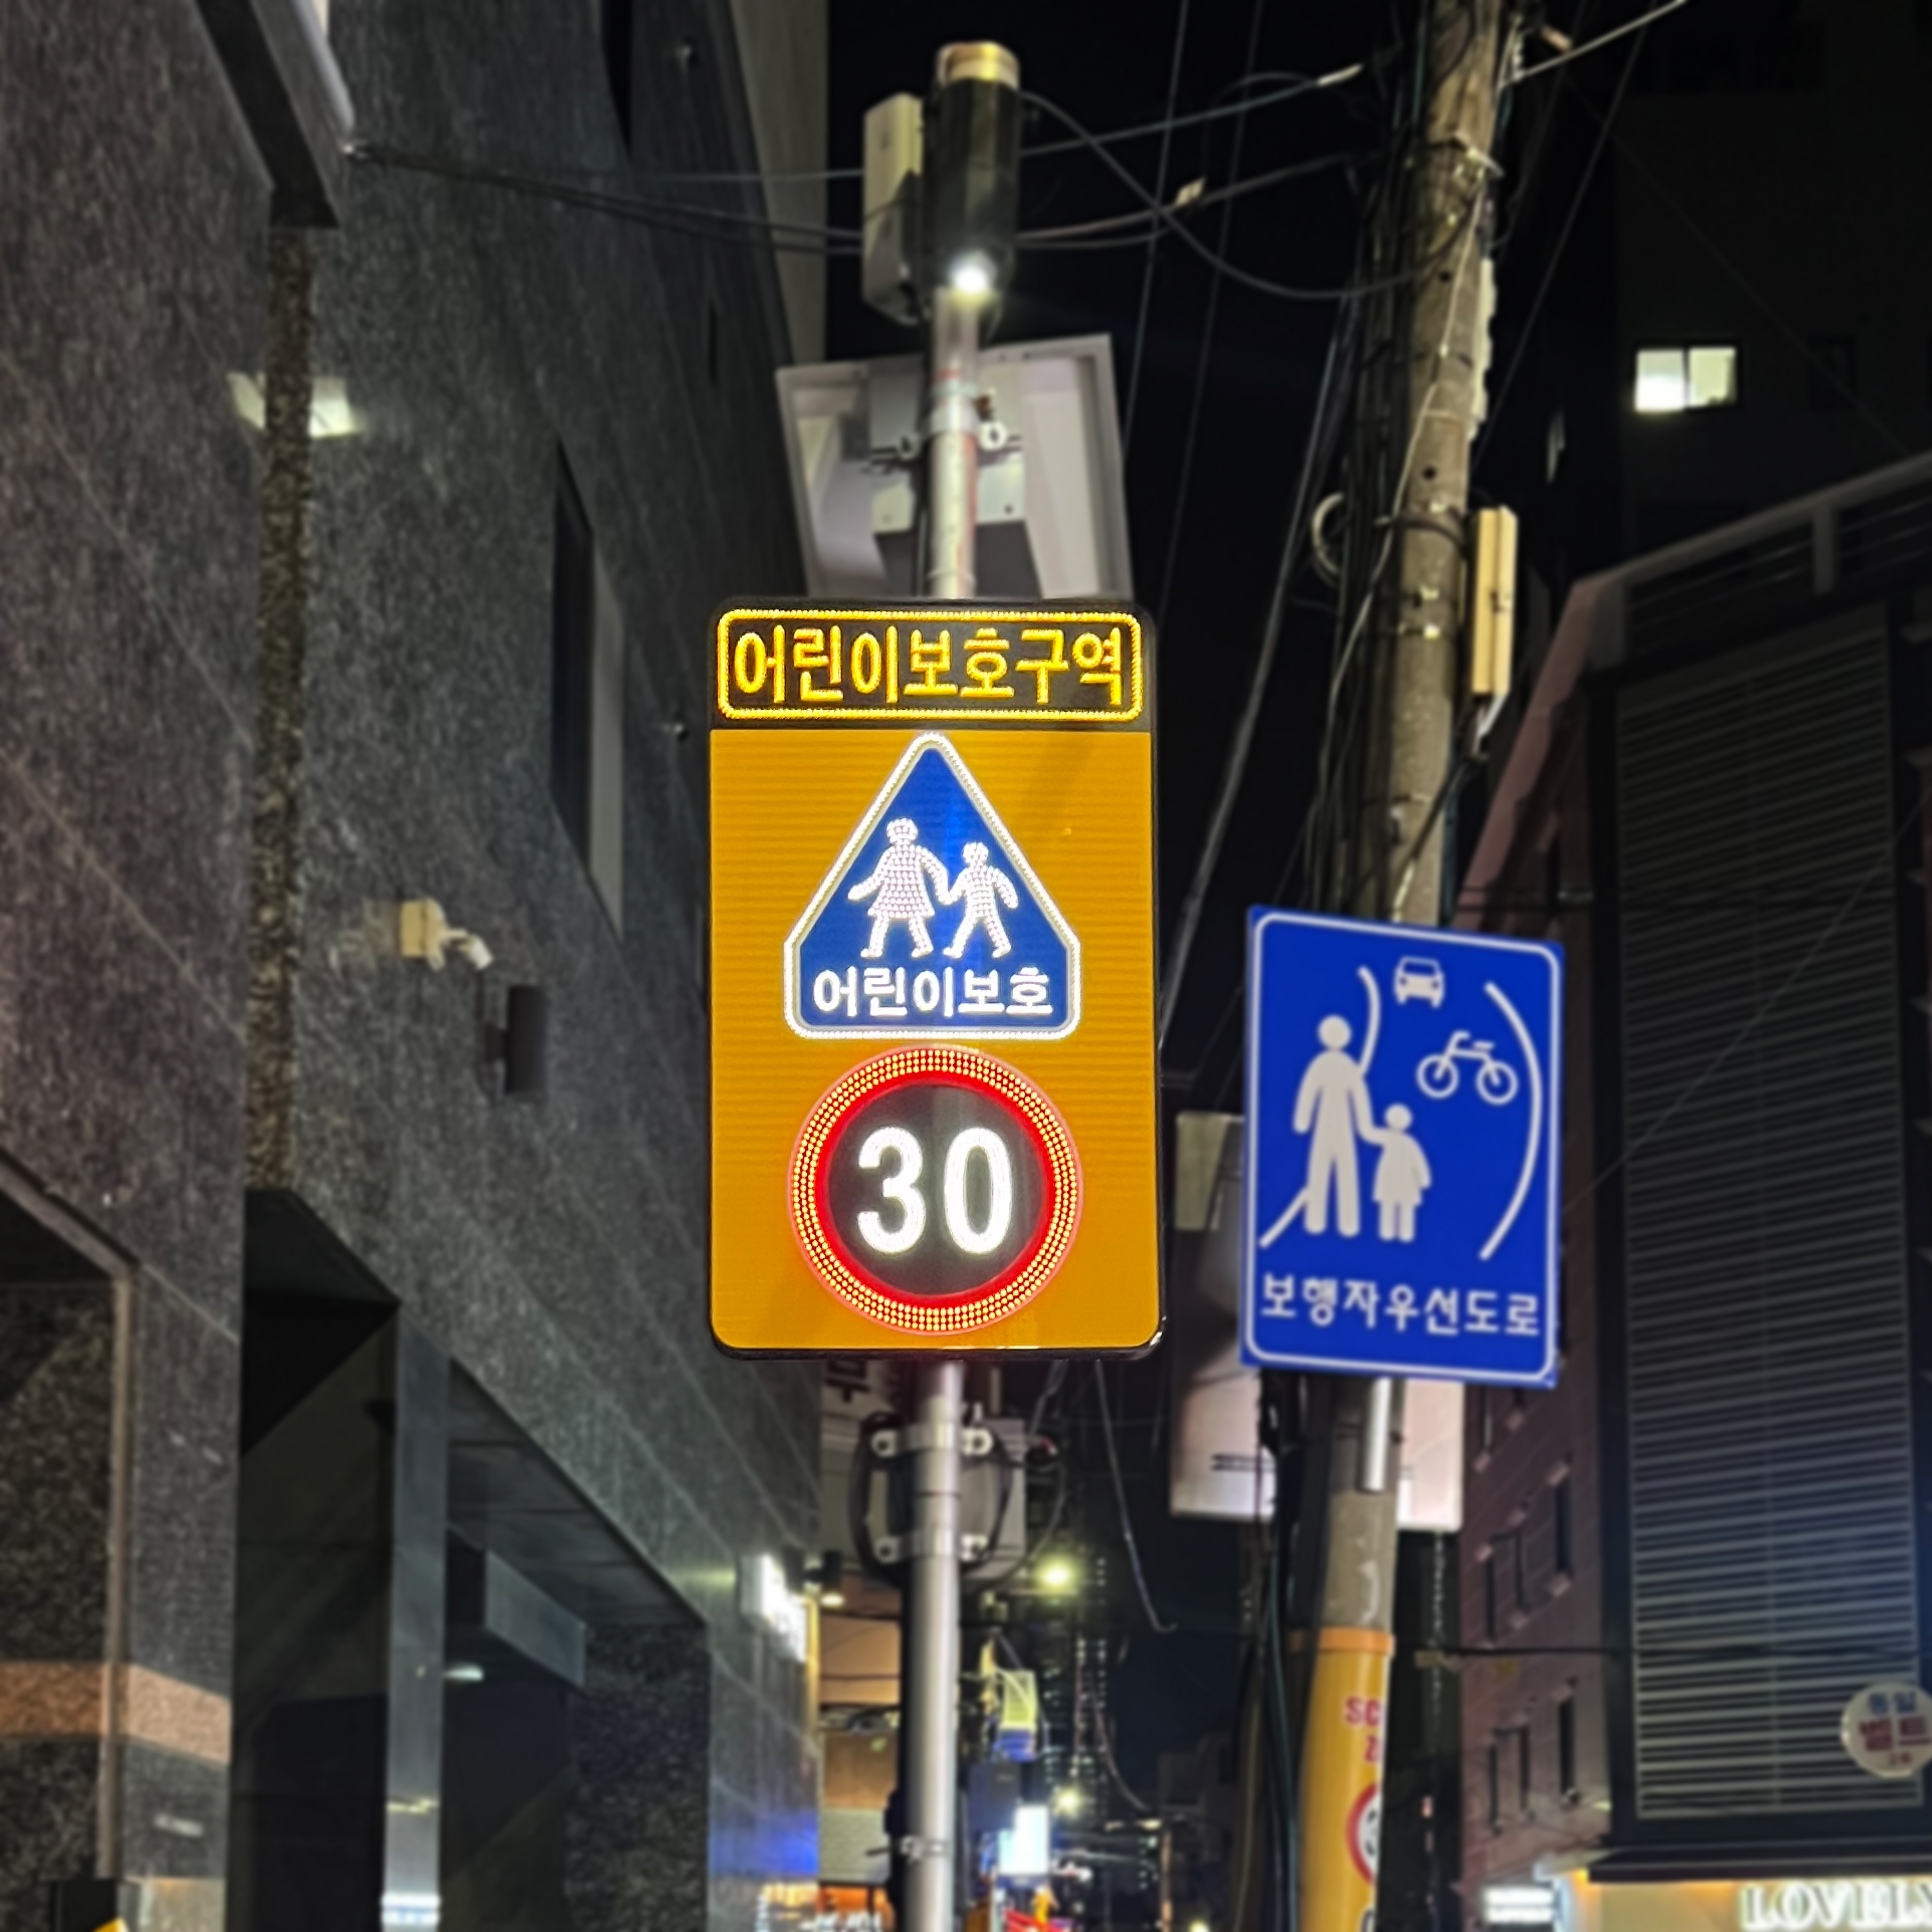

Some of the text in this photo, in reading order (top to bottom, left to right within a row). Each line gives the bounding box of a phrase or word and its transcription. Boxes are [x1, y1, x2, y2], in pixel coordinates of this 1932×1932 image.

[733, 623, 1123, 706] 어린이보호구역
[812, 965, 1055, 1018] 어린이보호
[857, 1126, 1013, 1255] 30
[1260, 1272, 1540, 1337] 보행자우선도로
